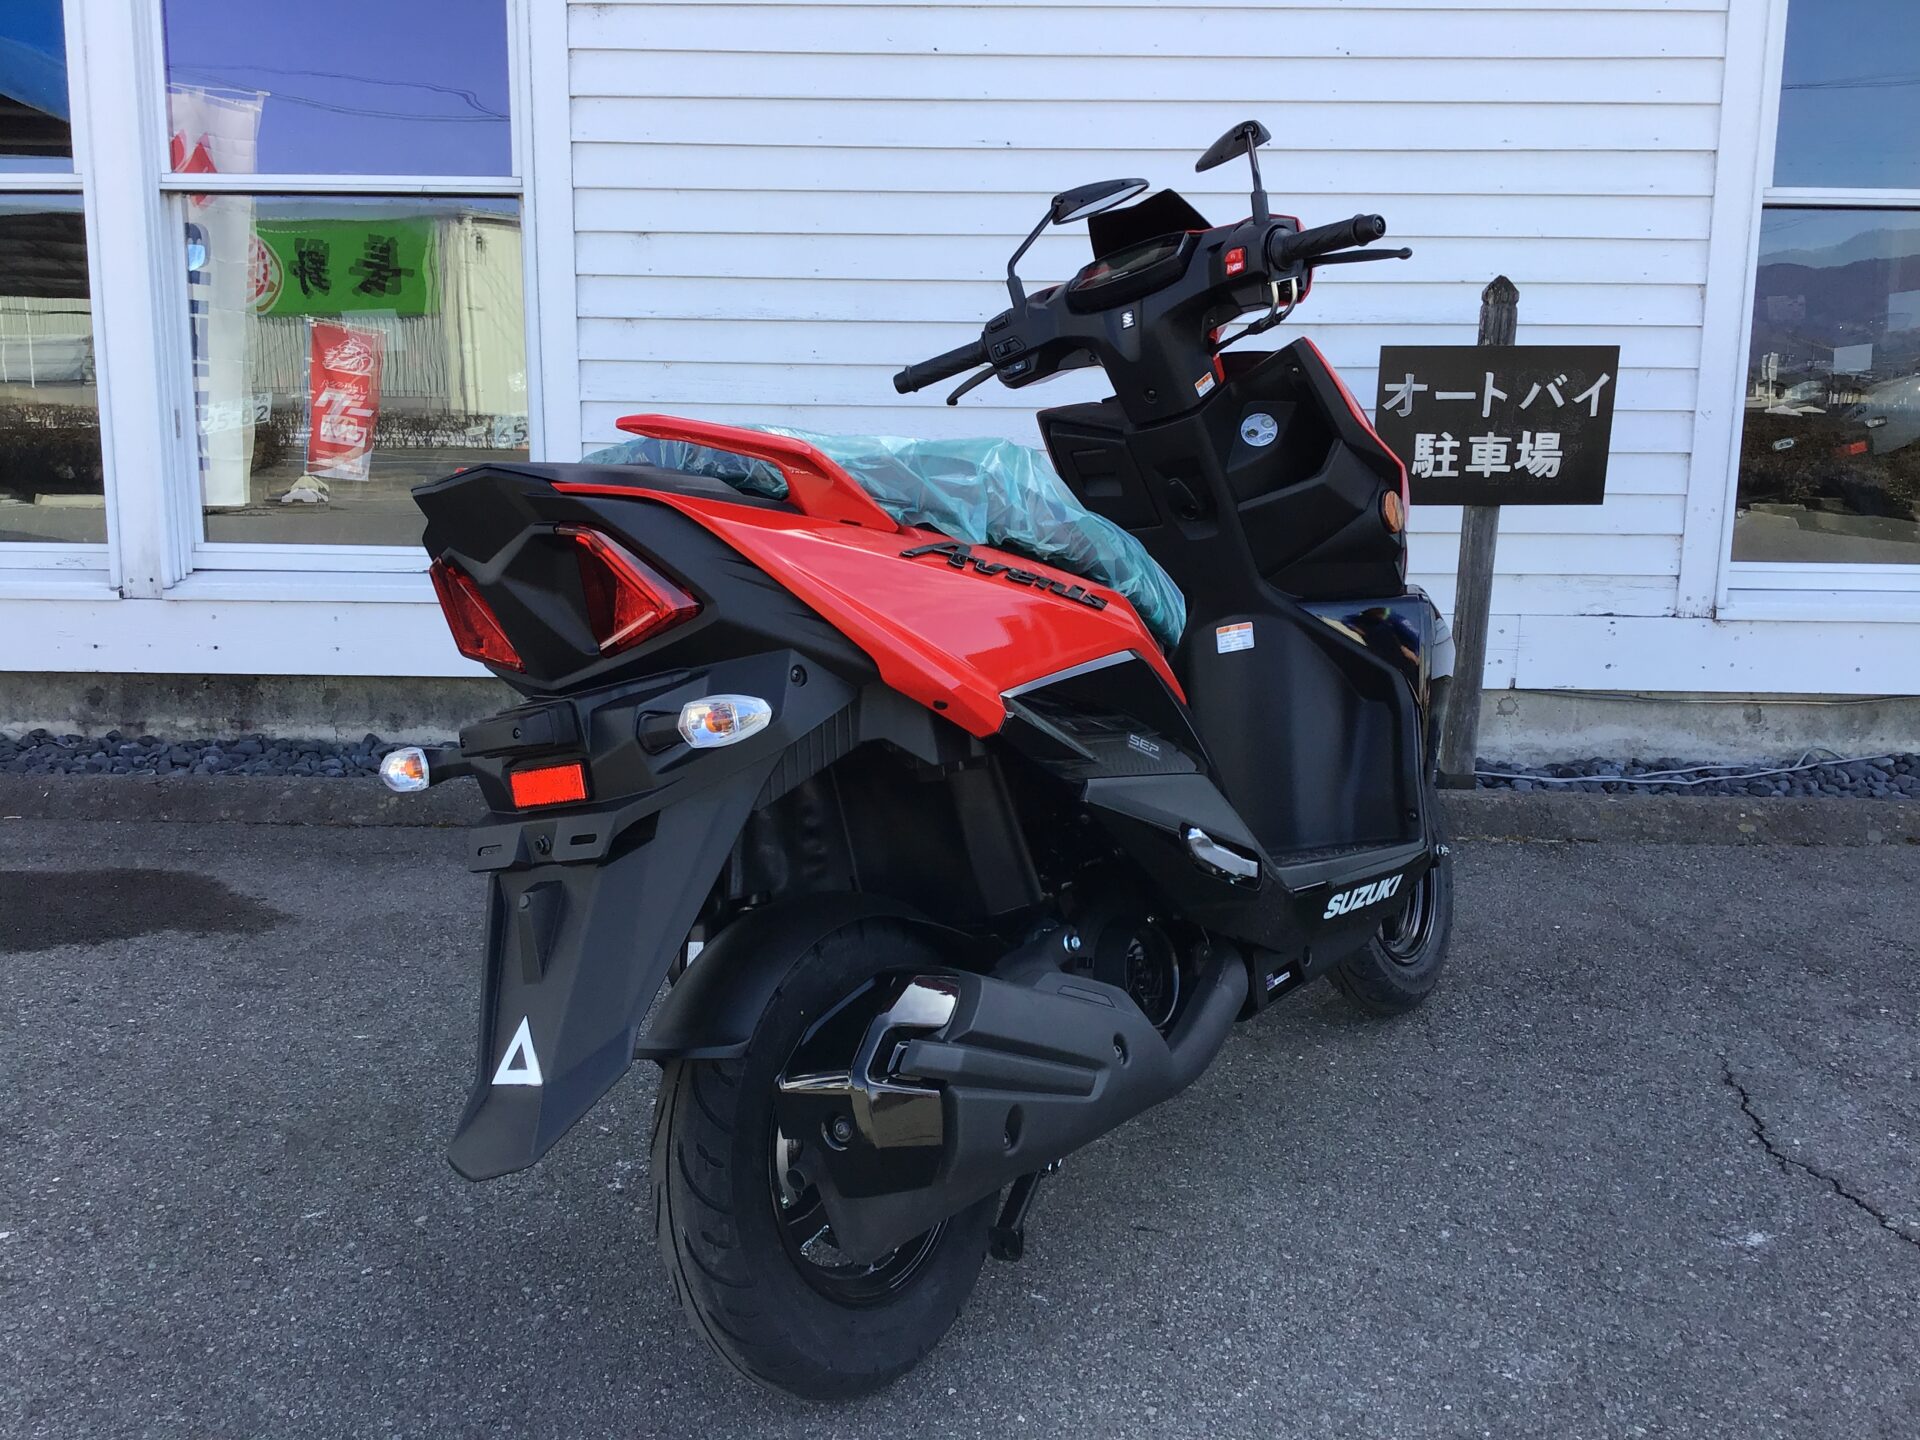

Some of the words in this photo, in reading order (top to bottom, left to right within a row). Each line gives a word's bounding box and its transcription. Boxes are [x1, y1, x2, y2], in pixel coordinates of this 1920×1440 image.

[1382, 371, 1611, 418] オートバイ
[1411, 430, 1563, 478] 駐車場
[1323, 873, 1404, 920] SUZUKI
